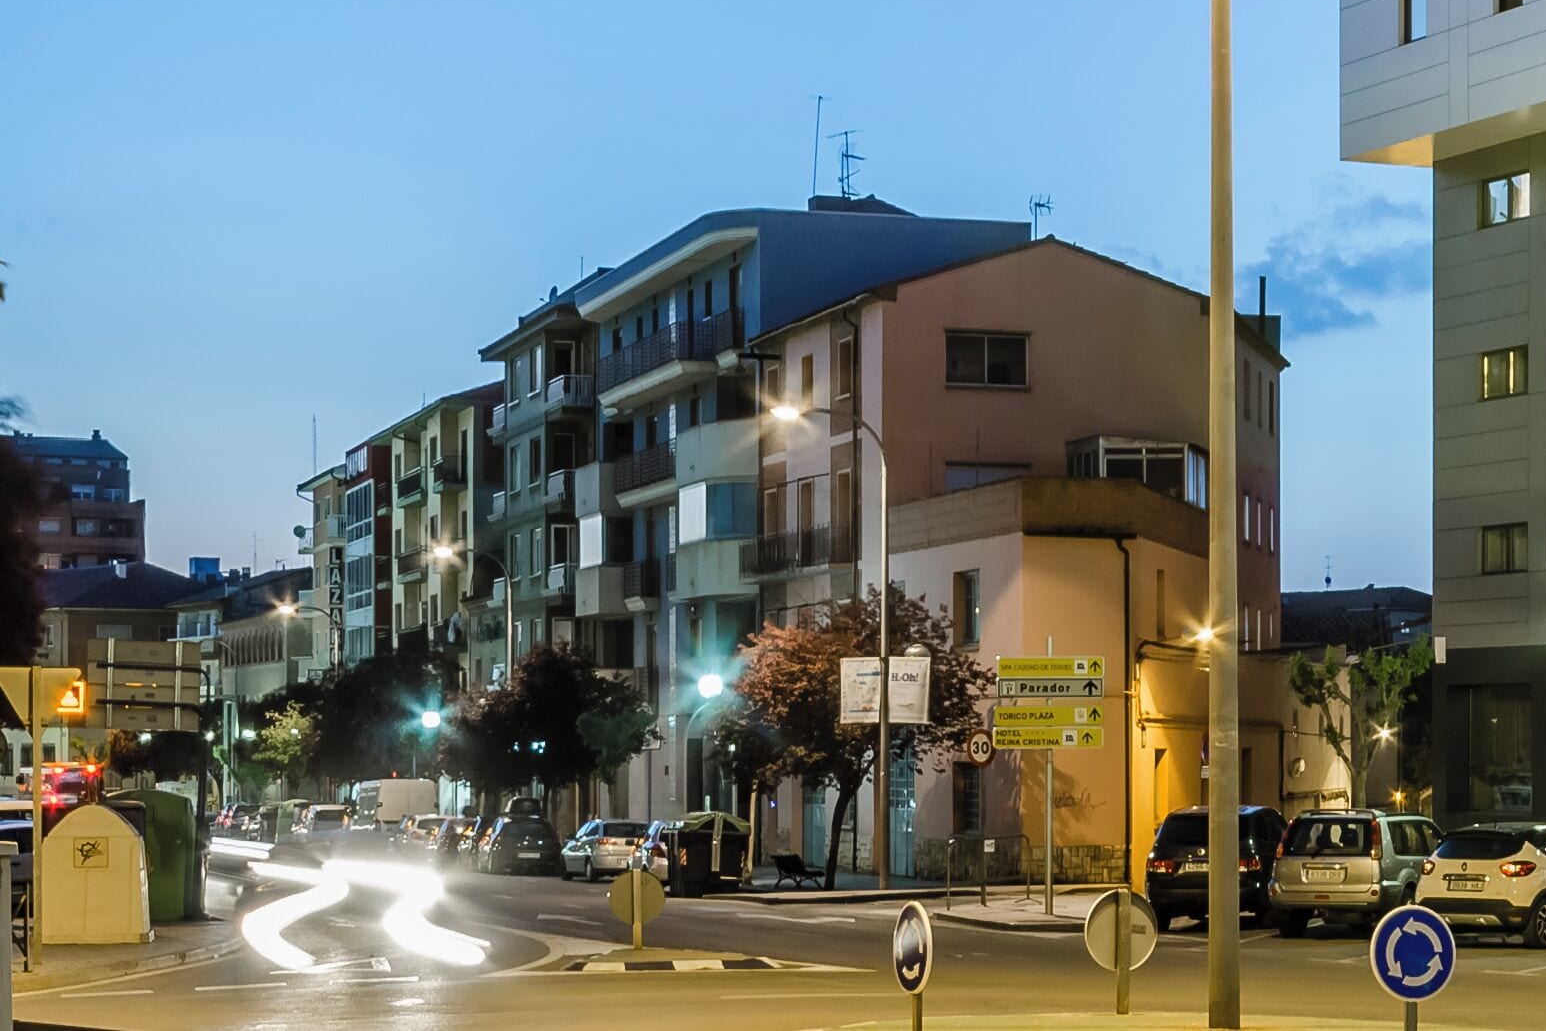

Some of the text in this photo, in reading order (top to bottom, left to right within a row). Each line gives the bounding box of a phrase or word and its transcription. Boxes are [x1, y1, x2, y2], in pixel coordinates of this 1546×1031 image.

[1020, 683, 1071, 693] Parador
[999, 712, 1055, 720] TORICO PLAZA
[972, 742, 990, 754] 30
